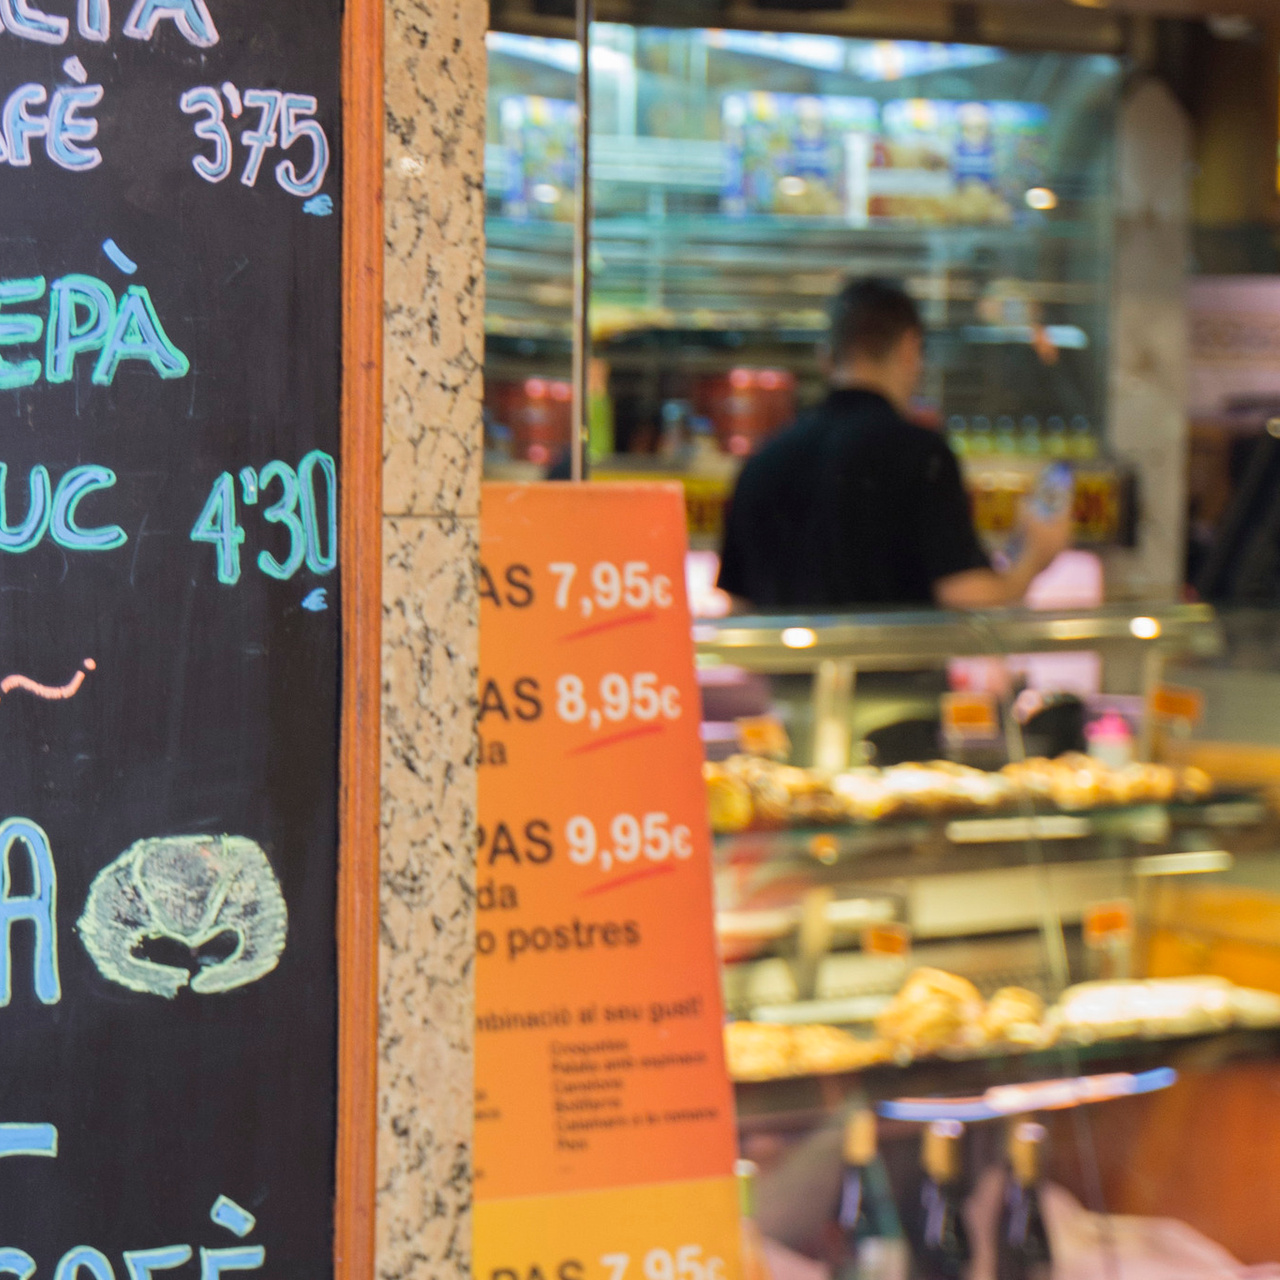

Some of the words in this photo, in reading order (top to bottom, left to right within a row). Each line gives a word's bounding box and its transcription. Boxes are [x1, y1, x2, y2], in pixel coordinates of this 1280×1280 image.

[548, 561, 674, 618] 7,95€
[556, 672, 682, 731] 8,95€
[565, 812, 693, 872] 9,95€
[507, 915, 641, 963] postres
